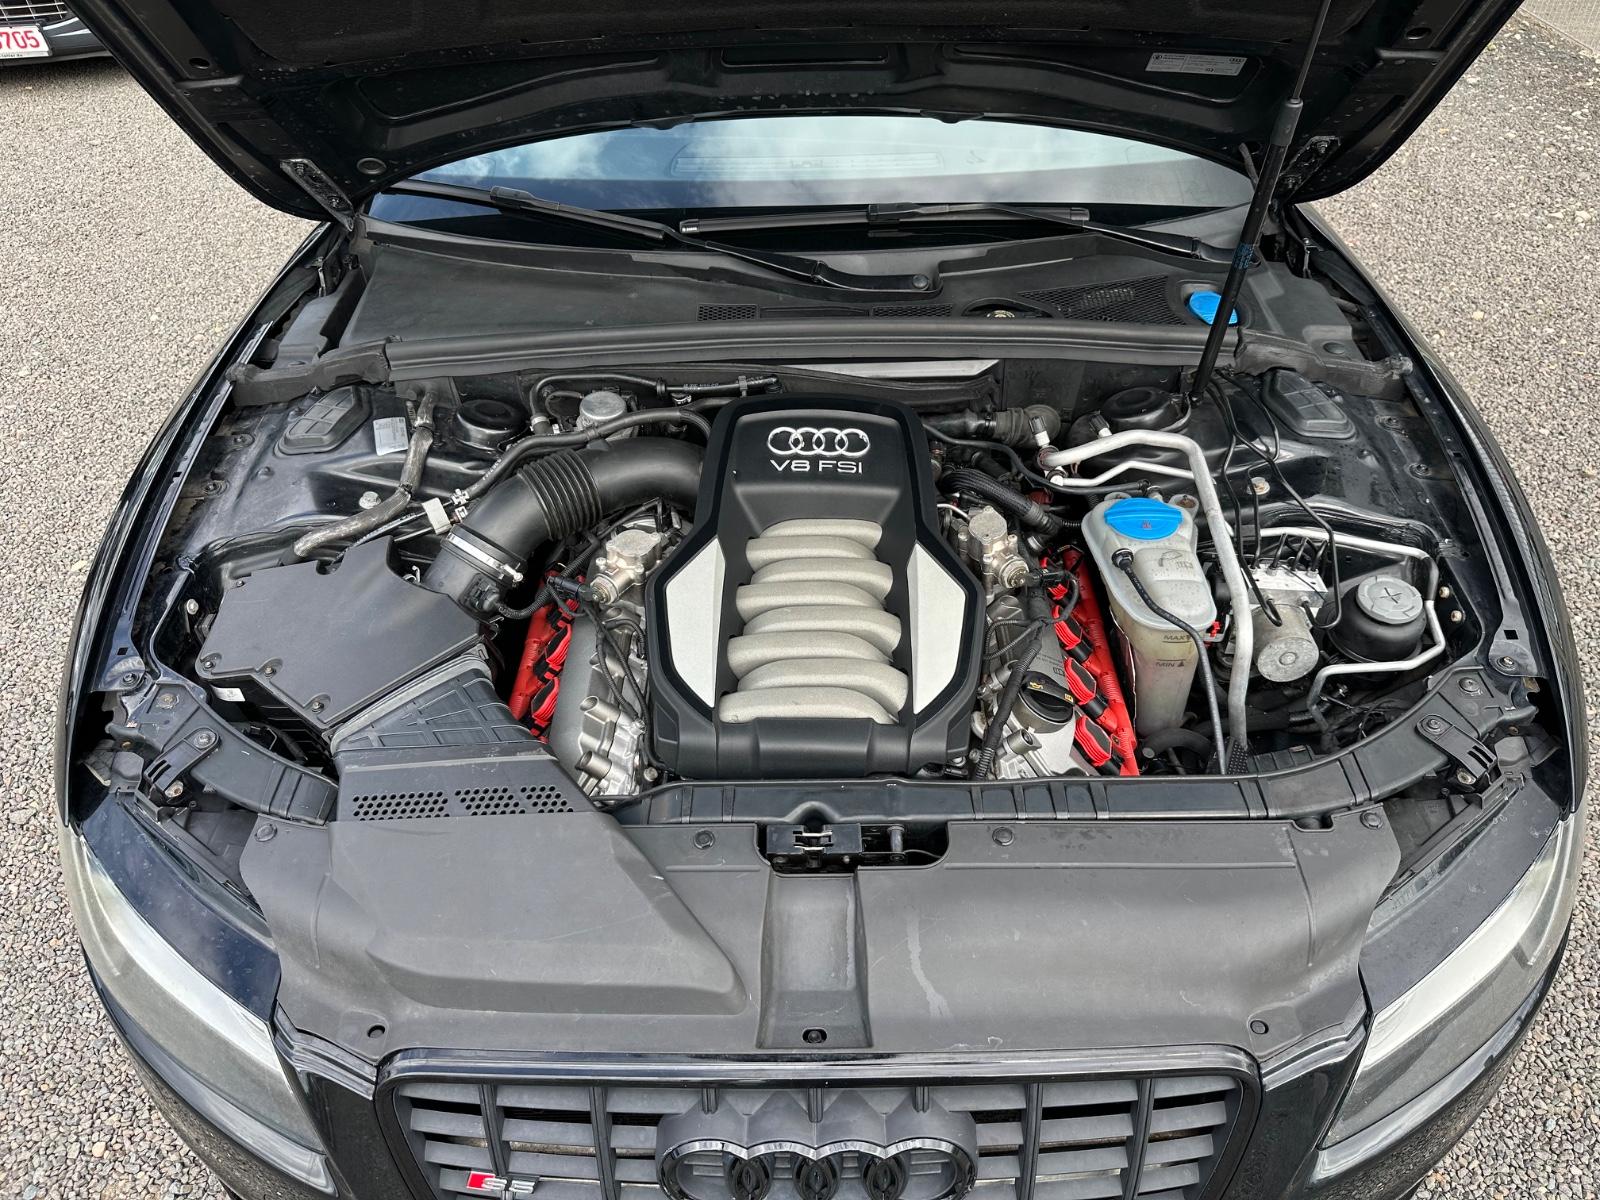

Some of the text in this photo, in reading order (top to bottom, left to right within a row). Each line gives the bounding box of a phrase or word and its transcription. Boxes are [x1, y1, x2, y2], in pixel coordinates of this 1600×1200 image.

[0, 30, 40, 49] 705
[770, 459, 863, 474] V8 FSI
